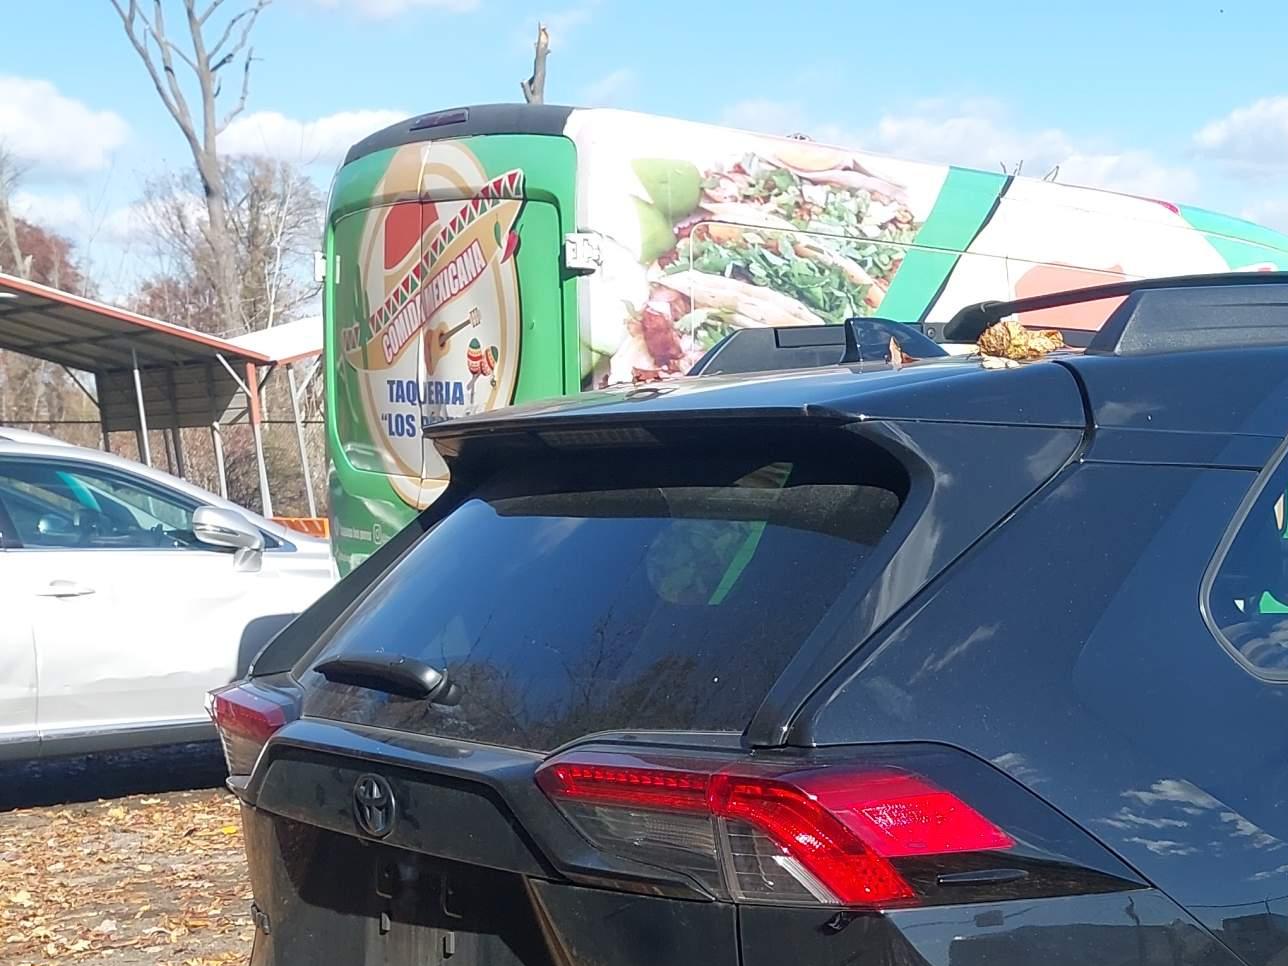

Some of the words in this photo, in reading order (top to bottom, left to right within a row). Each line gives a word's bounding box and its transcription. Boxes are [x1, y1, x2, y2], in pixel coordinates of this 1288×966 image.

[382, 292, 426, 363] COMIDA
[423, 238, 487, 320] MEXICANA
[387, 380, 464, 405] TAQUERIA
